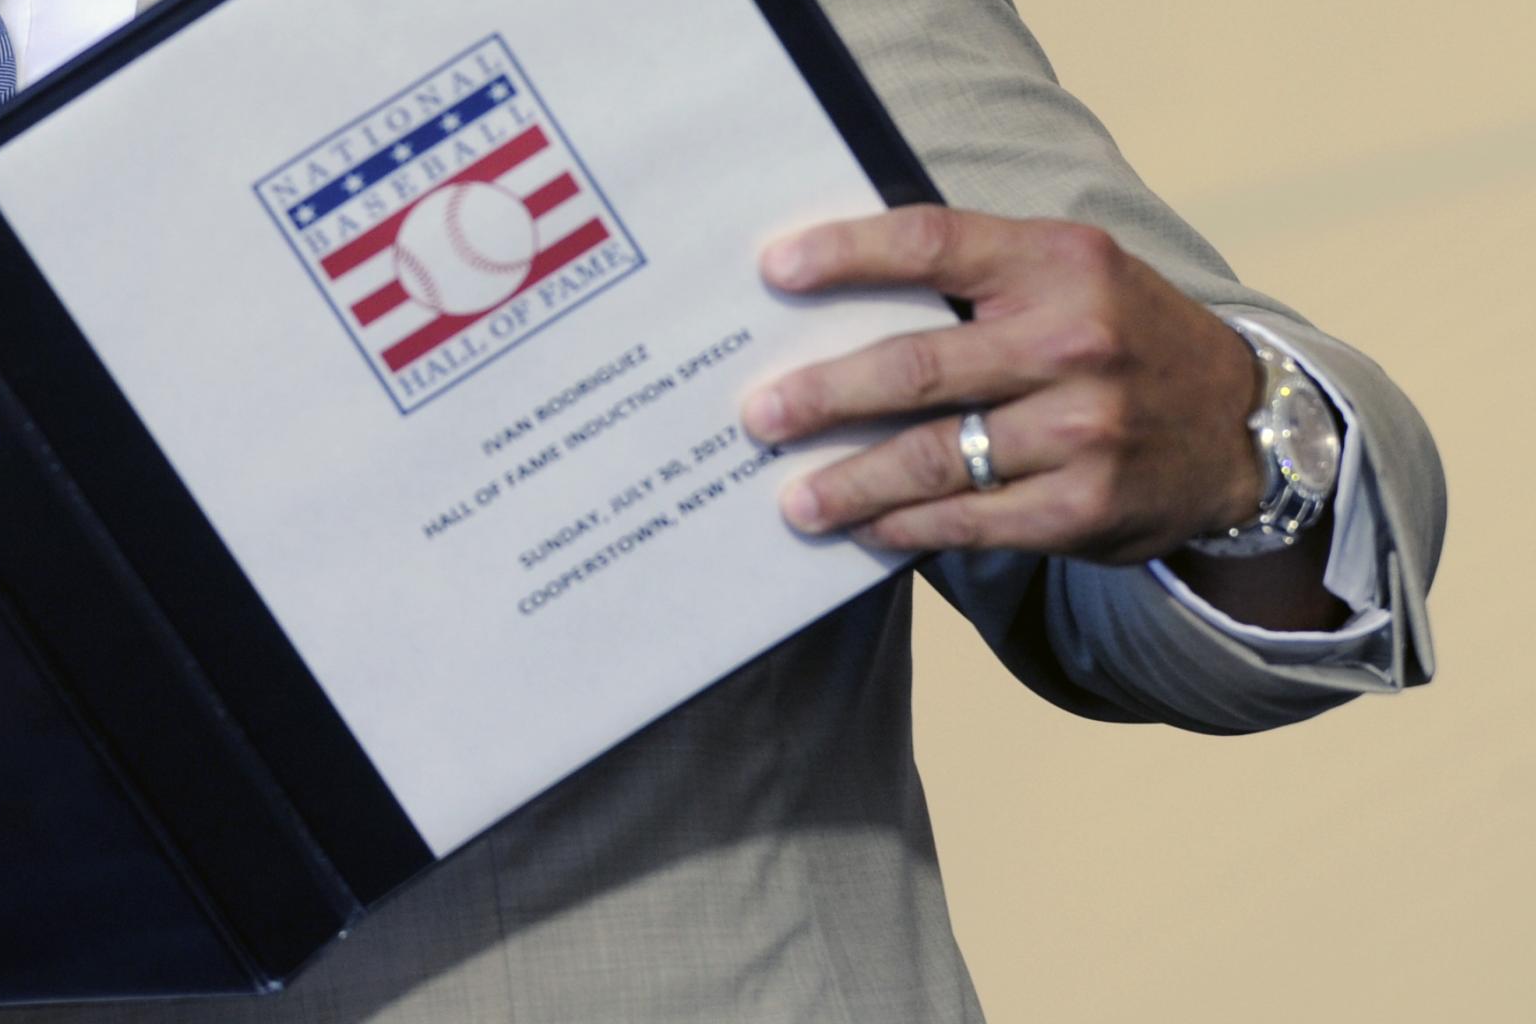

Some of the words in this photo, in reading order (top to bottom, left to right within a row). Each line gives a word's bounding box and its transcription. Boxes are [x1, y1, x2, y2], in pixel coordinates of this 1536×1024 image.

[270, 50, 506, 204] NATIONAL
[303, 104, 537, 257] BASEBALL
[395, 334, 489, 400] HALL
[488, 298, 534, 343] OF
[536, 240, 636, 311] FAME
[422, 501, 473, 540] HALL
[474, 479, 501, 507] OF
[503, 443, 562, 487] FAME
[564, 374, 676, 450] INDUCTION
[675, 327, 752, 380] SPEECH
[482, 416, 533, 456] IVAN
[518, 508, 611, 570] SUNDAY,
[610, 475, 654, 514] JULY
[657, 459, 691, 484] 30,
[690, 425, 738, 463] 2017
[517, 513, 678, 616] COOPERSTOWN,
[677, 478, 727, 516] NEW
